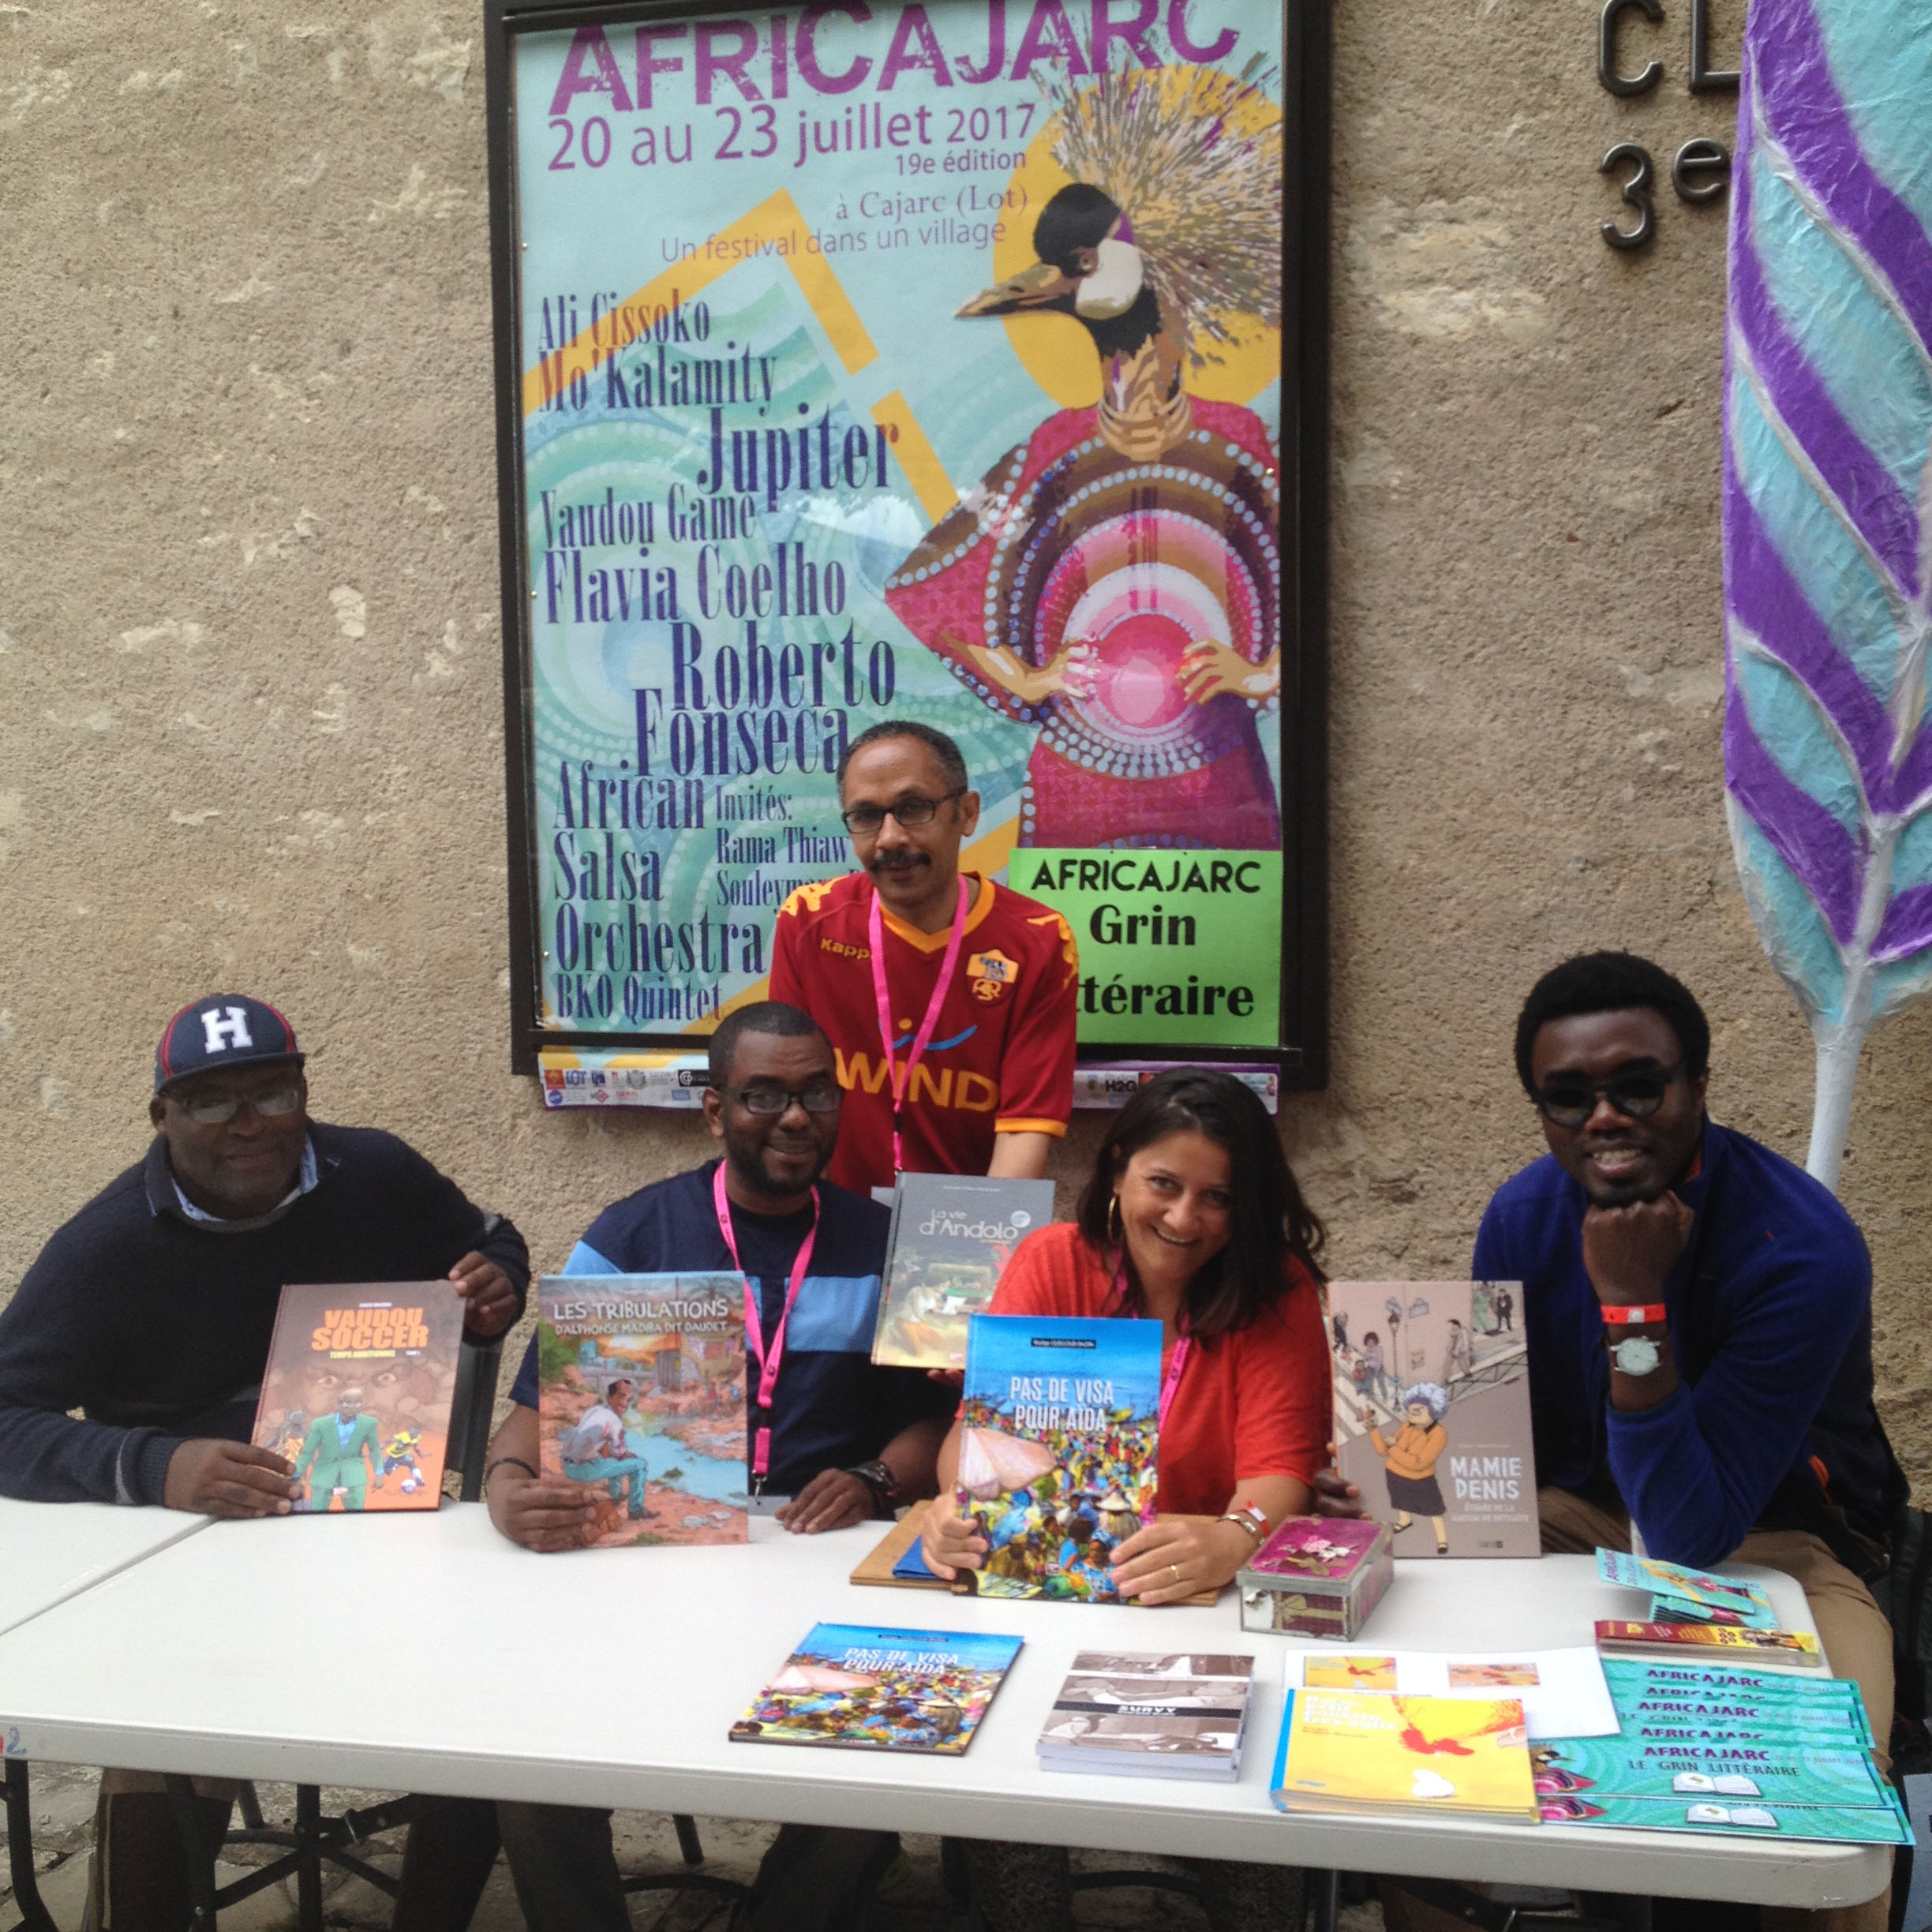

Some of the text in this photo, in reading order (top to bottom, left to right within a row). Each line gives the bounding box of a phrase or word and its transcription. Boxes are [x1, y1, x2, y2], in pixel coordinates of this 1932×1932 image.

[548, 0, 1240, 115] AFRICAJARC
[548, 102, 1035, 170] 20 au 23 juillet 2017
[897, 150, 1026, 176] 19e édition
[836, 185, 1028, 223] à Cajarc (Lot)
[661, 219, 1006, 262] Un festival dans un village
[537, 288, 710, 350] Ali Cissoko
[538, 341, 777, 417] Mo'Kalamity
[697, 402, 900, 513] Jupiter
[539, 482, 756, 549] Vaudou Game
[544, 541, 845, 624] Flavia Coelho
[668, 618, 896, 711] Roberto
[632, 687, 849, 777] Fonseca
[554, 761, 706, 829] African
[715, 784, 793, 822] Invités:
[716, 826, 850, 864] Rama Thiaw
[554, 832, 665, 901] Salsa
[1031, 859, 1261, 893] AFRICAJARC
[555, 903, 766, 974] Orchestra
[1090, 904, 1196, 945] Grin
[821, 938, 871, 960] Kapp
[555, 973, 724, 1024] BKO Quintet
[1076, 974, 1254, 1017] téraire
[201, 1006, 253, 1054] H
[834, 1047, 999, 1112] WIND
[324, 1307, 423, 1329] VAUDOU
[554, 1299, 728, 1320] LES TRIBULATIONS
[311, 1325, 429, 1351] SOCCER
[1010, 1376, 1114, 1405] PAS DE VISA
[1015, 1404, 1064, 1430] POUR
[1450, 1456, 1522, 1477] MAMIE
[1455, 1477, 1519, 1500] DENIS
[843, 1659, 895, 1672] POUR
[844, 1647, 882, 1659] PAS
[917, 1652, 959, 1664] VISA
[1647, 1669, 1765, 1687] AFRICAJARC
[1638, 1701, 1759, 1717] AFRICAJARC
[1628, 1760, 1647, 1770] LE
[1659, 1761, 1698, 1772] GRIN
[1644, 1747, 1770, 1761] AFRICAJARC
